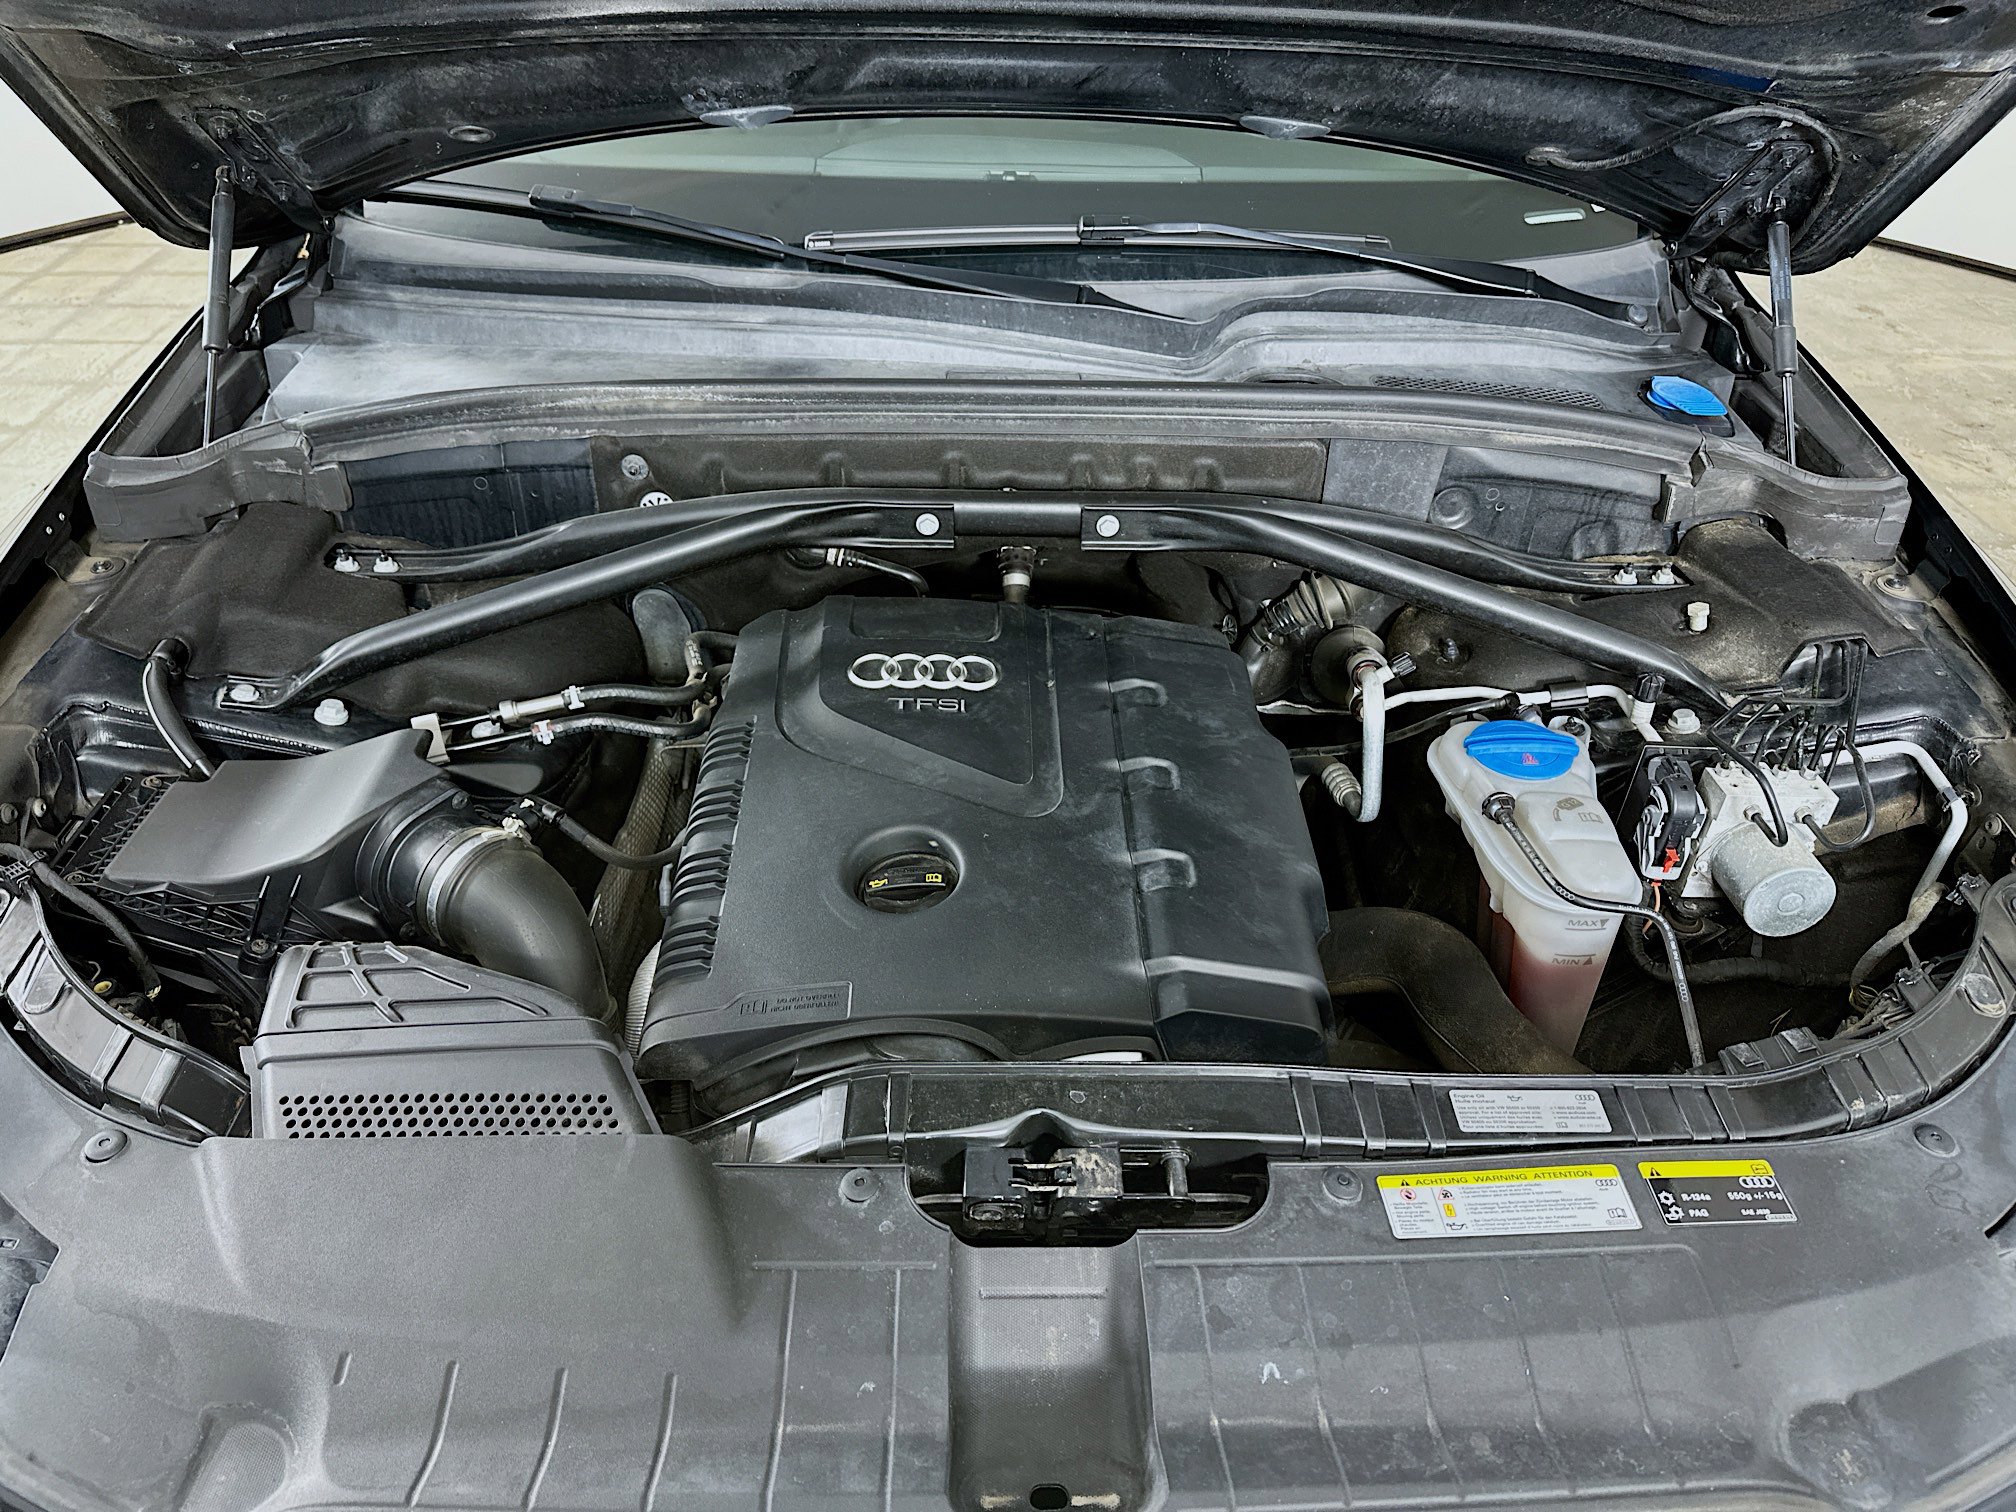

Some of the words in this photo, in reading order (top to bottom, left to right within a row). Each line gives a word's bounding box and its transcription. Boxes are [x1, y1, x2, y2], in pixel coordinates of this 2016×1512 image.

[887, 698, 966, 712] TFSI
[1416, 1176, 1468, 1186] ACHTUNG
[1473, 1173, 1527, 1182] WARNING
[1534, 1170, 1593, 1180] ATTENTION
[1727, 1192, 1752, 1201] 550g
[1688, 1209, 1709, 1217] PAG
